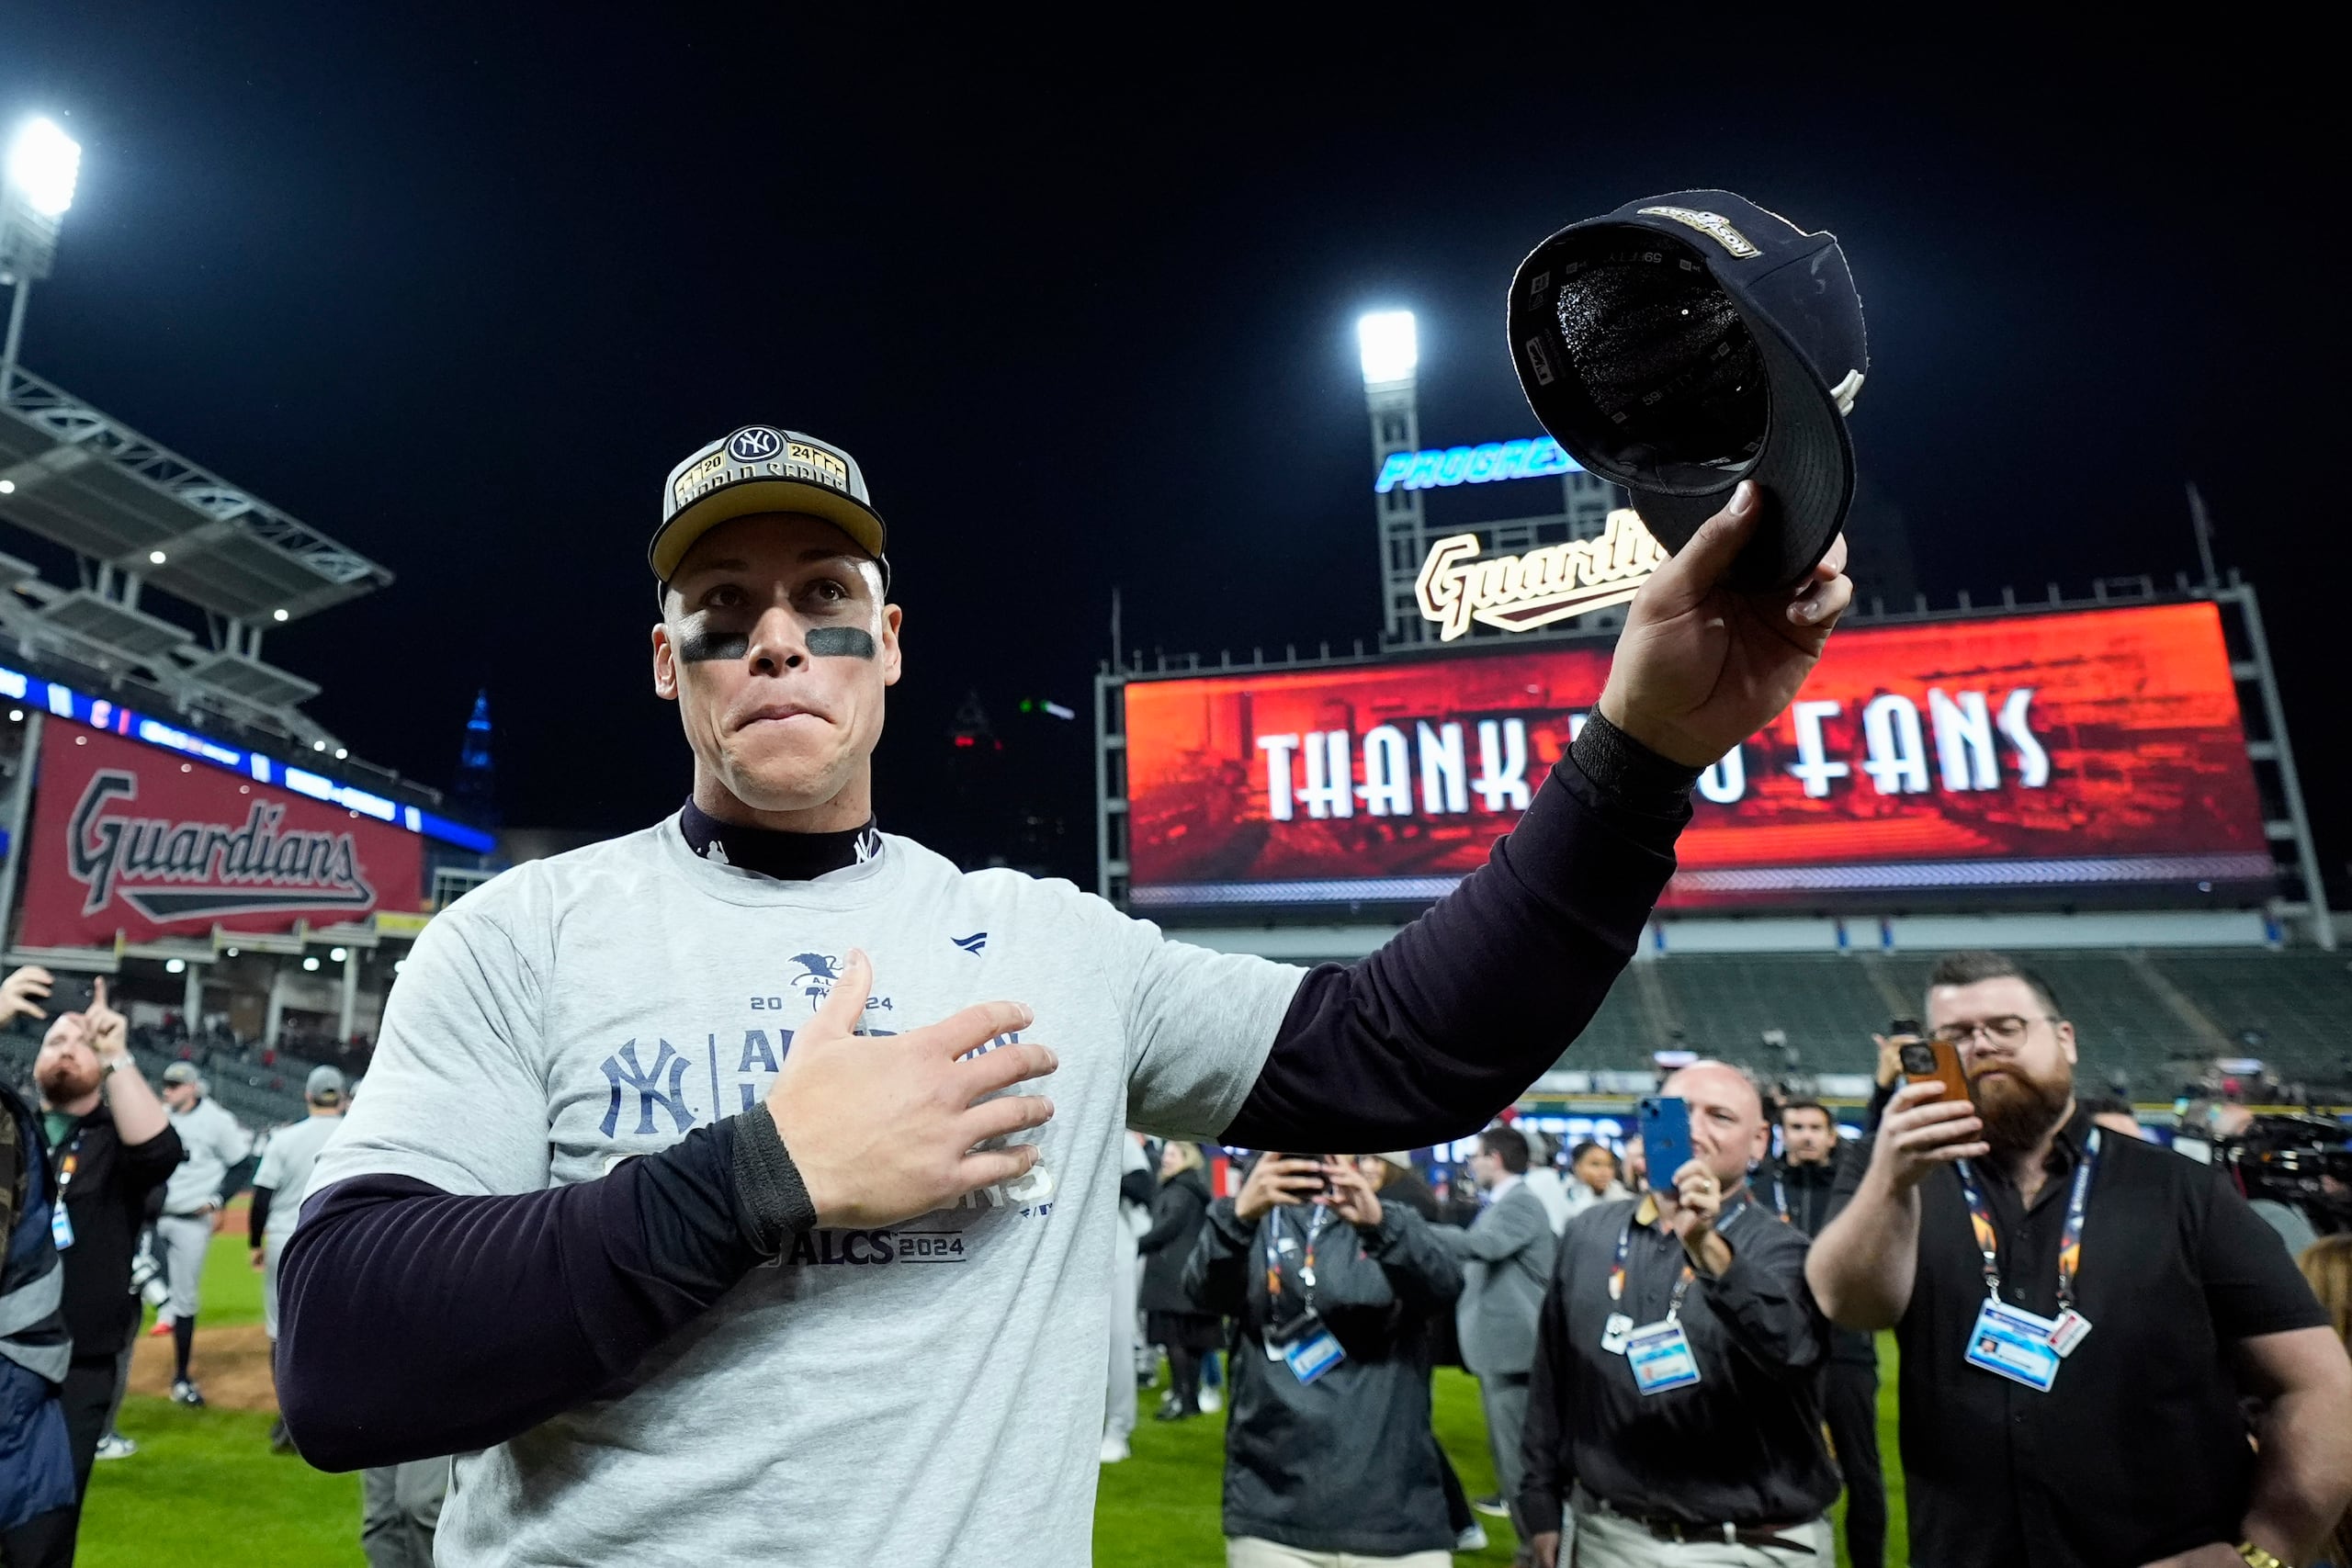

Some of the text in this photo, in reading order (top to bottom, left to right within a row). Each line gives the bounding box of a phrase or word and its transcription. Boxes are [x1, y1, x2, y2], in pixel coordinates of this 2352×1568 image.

[705, 446, 810, 472] 20 24
[1415, 508, 1670, 642] Guardi
[1257, 715, 1532, 820] THANK
[1788, 688, 2051, 798] FANS
[66, 768, 377, 922] Guardians
[751, 997, 893, 1010] 20 24
[599, 1037, 696, 1139] NY
[899, 1238, 964, 1256] 2024
